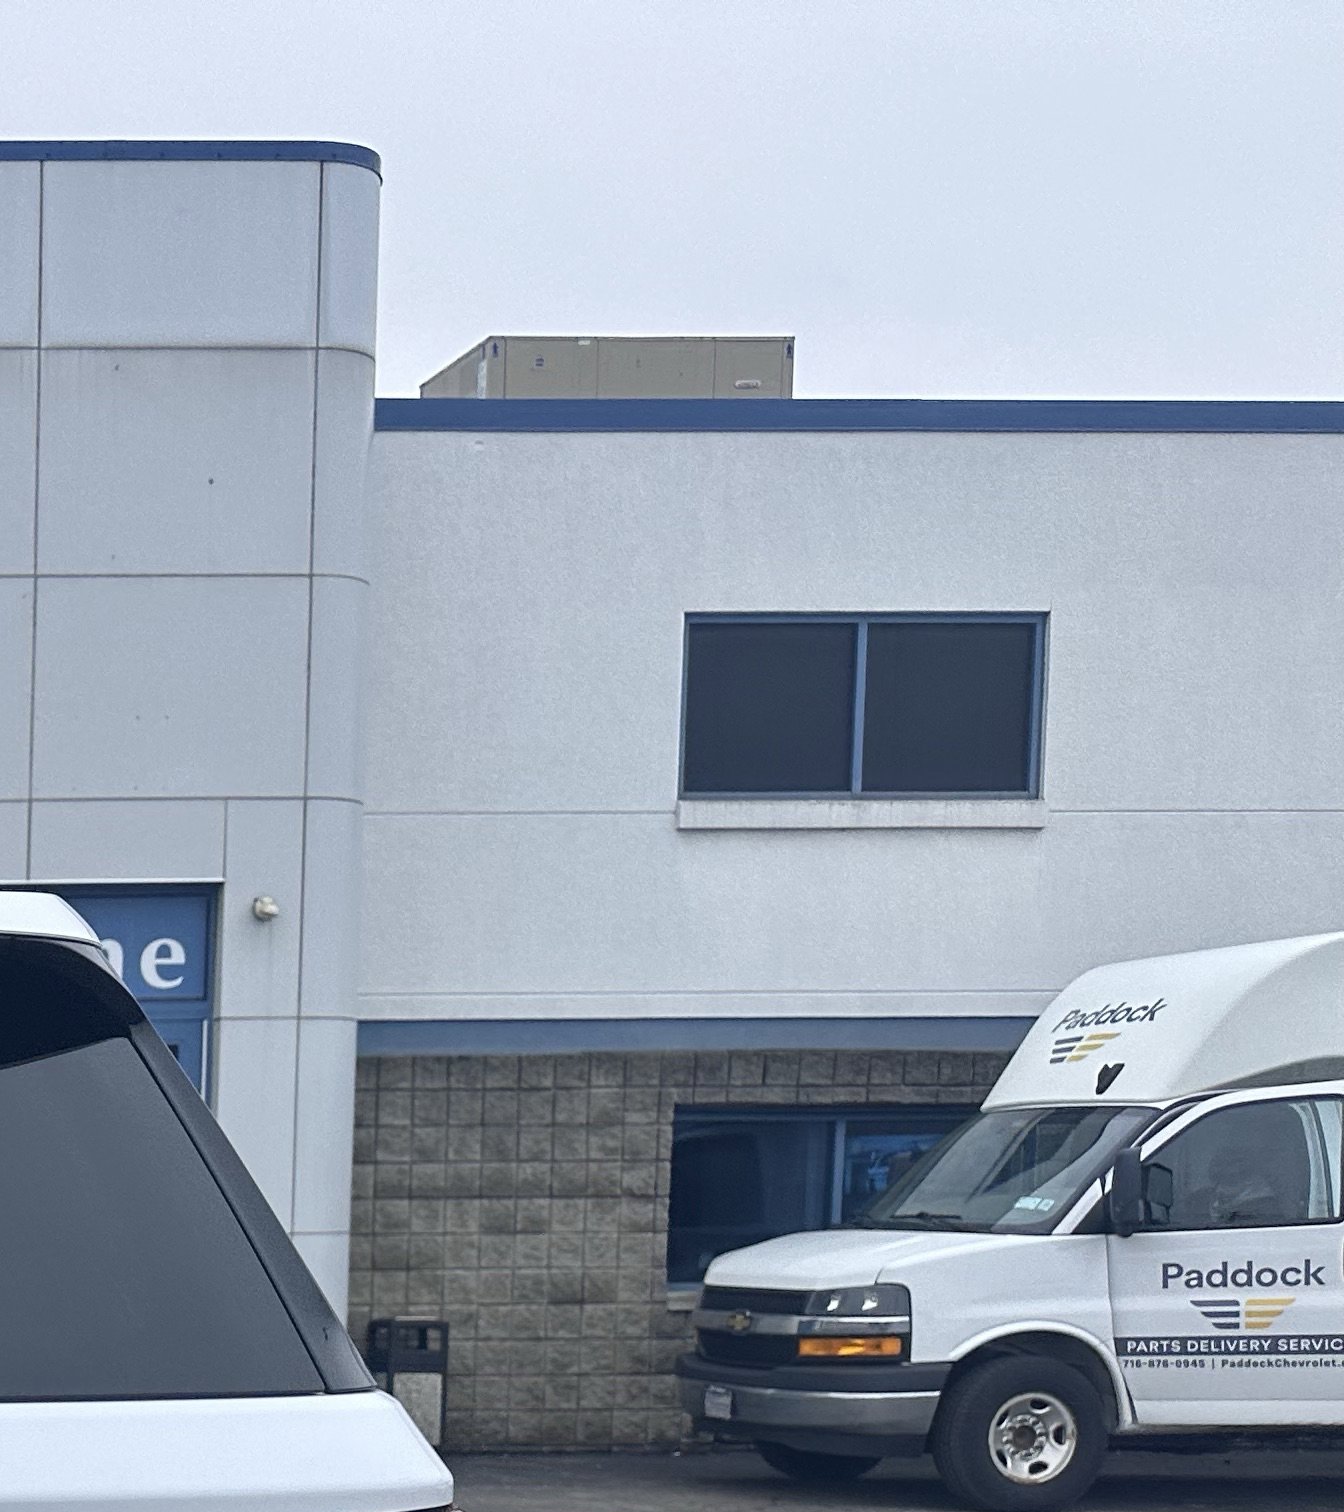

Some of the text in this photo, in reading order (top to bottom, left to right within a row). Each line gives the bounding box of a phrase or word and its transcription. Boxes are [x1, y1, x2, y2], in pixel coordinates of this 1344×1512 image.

[1052, 998, 1168, 1033] Paddock
[1162, 1259, 1326, 1289] Paddock
[1127, 1338, 1344, 1353] PARTS DELIVERY SERVIC
